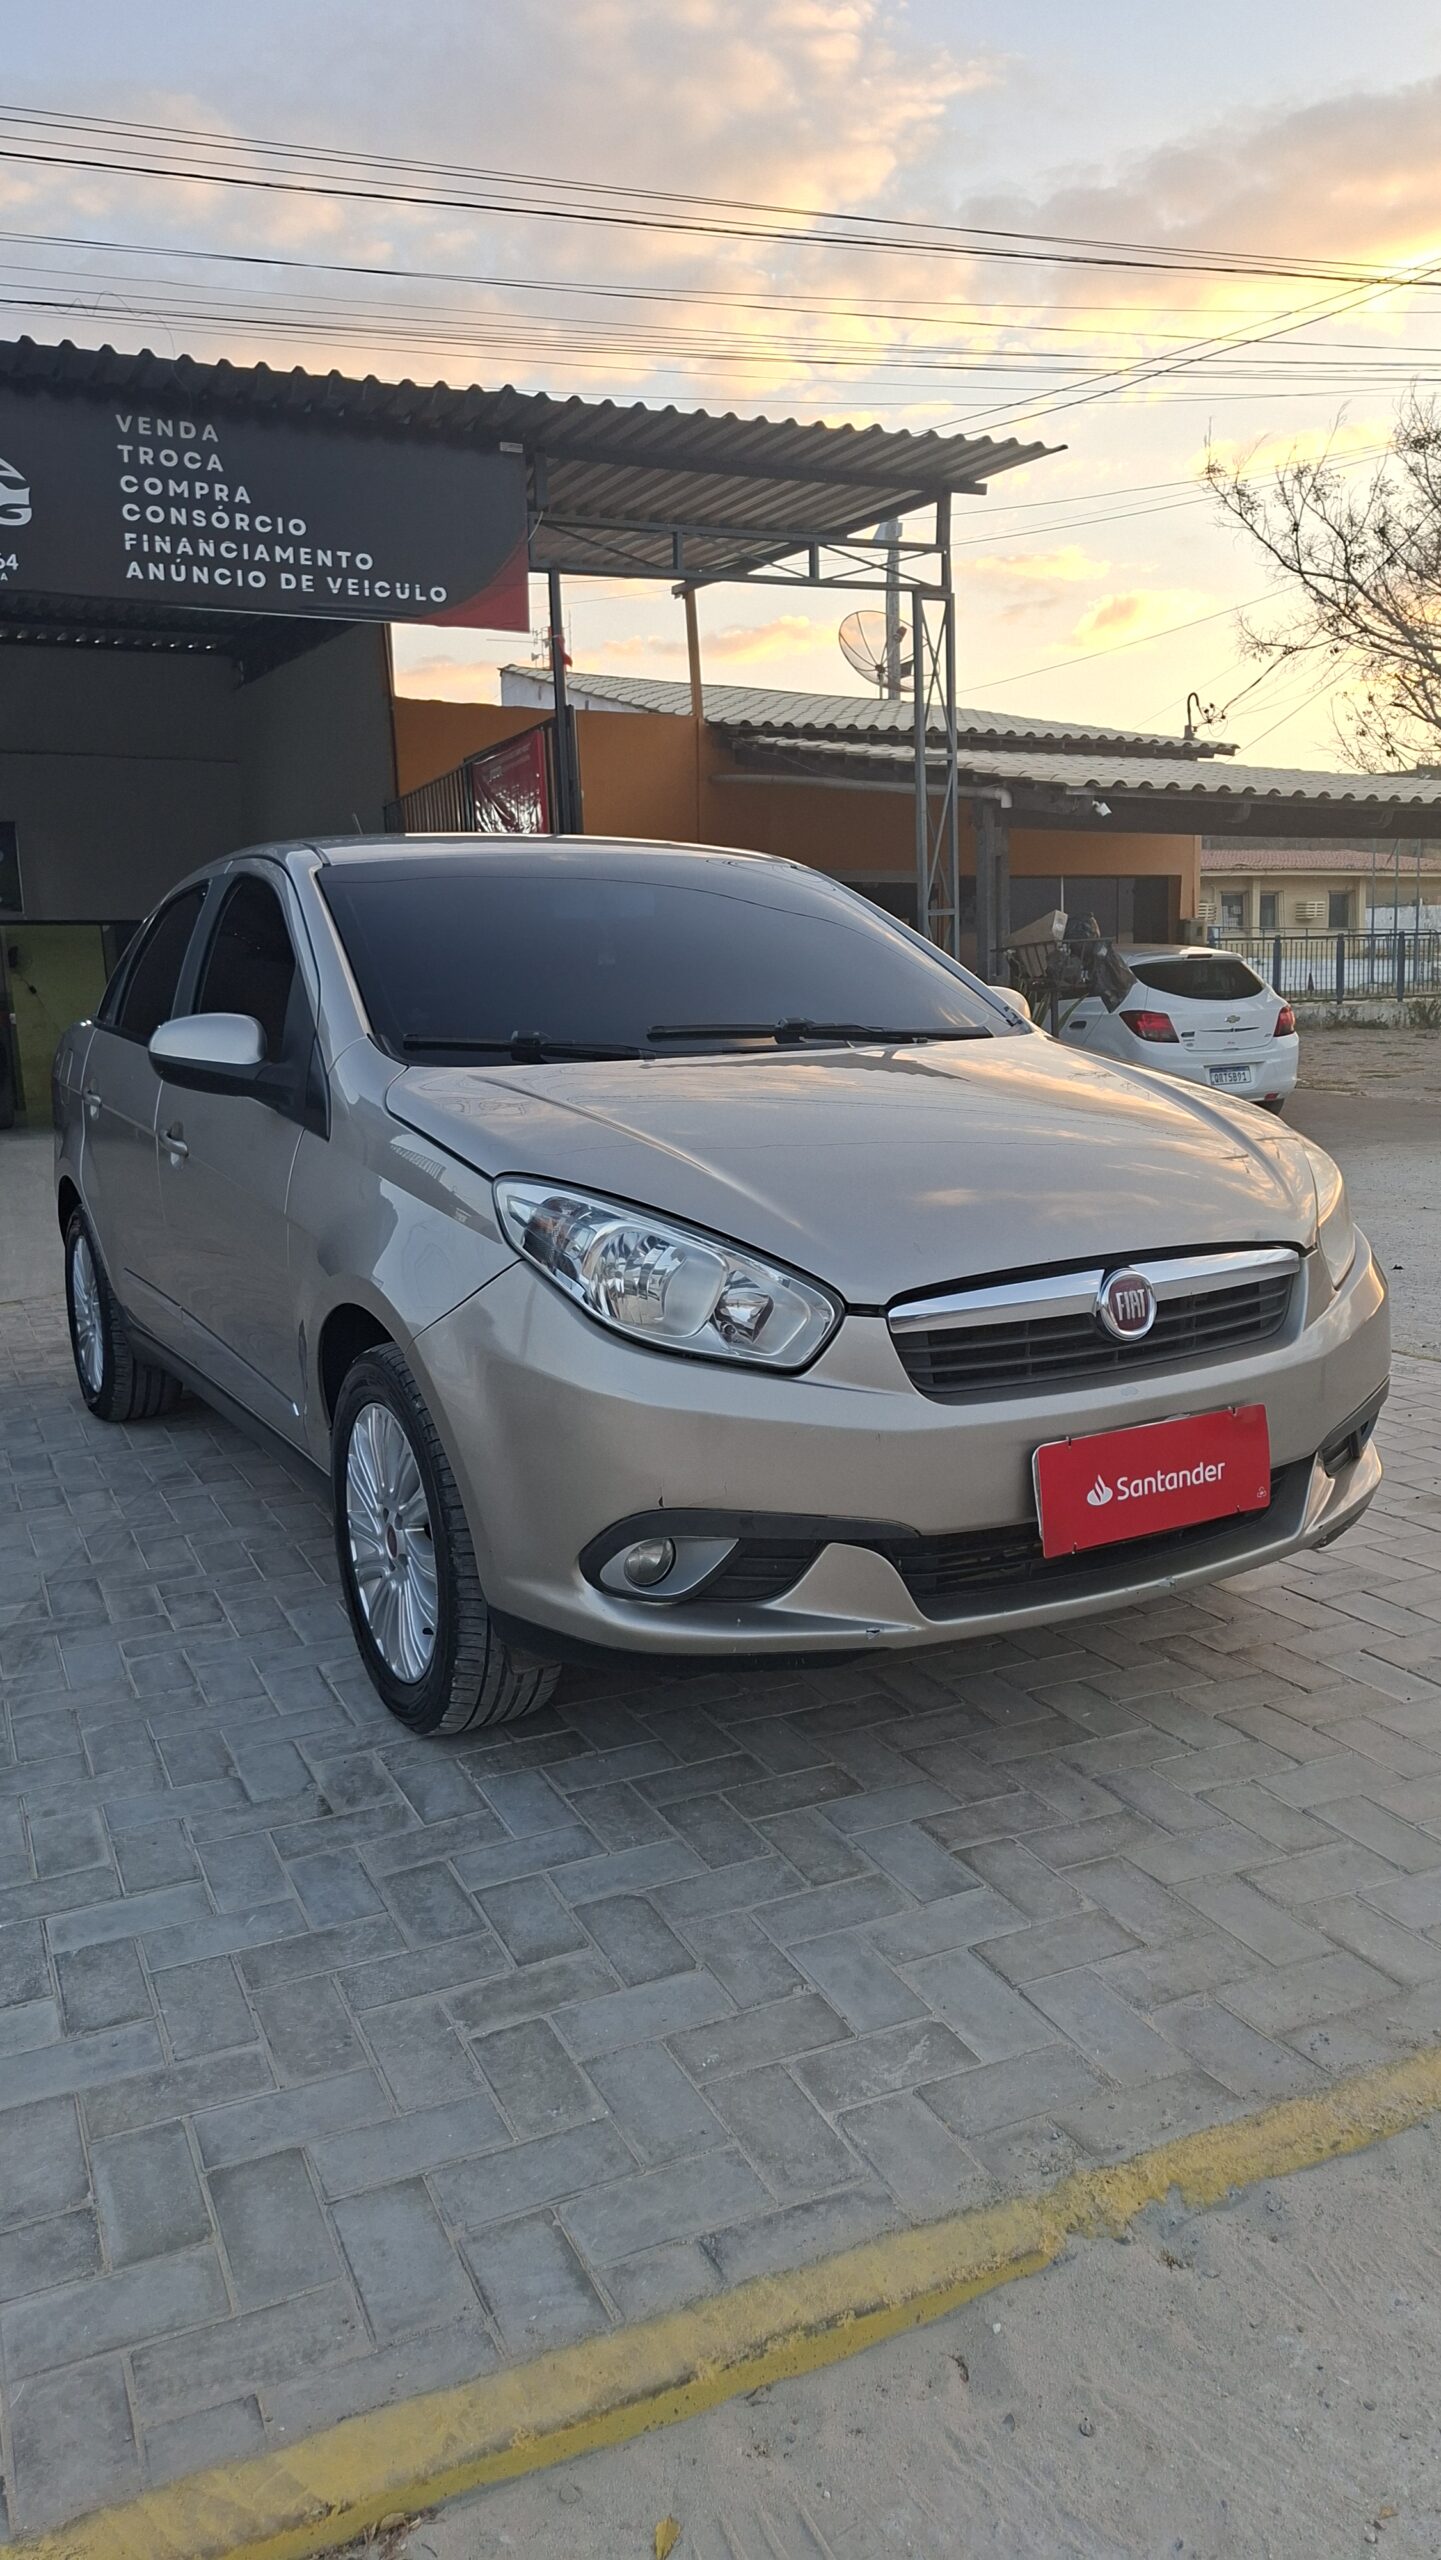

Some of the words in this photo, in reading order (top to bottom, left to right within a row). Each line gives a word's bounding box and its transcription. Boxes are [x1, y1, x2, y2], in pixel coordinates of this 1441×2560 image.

[115, 414, 219, 442] VENDA
[117, 444, 224, 472] TROCA
[119, 475, 251, 503] COMPRA
[122, 504, 307, 536] CONSÓRCIO
[124, 533, 374, 570] FINANCIAMENTO
[126, 558, 267, 588] ANÚNCIO
[280, 573, 315, 592] DE
[326, 576, 448, 603] VEICULO
[1115, 1288, 1146, 1320] FIAT
[1117, 1462, 1225, 1500] Santander
